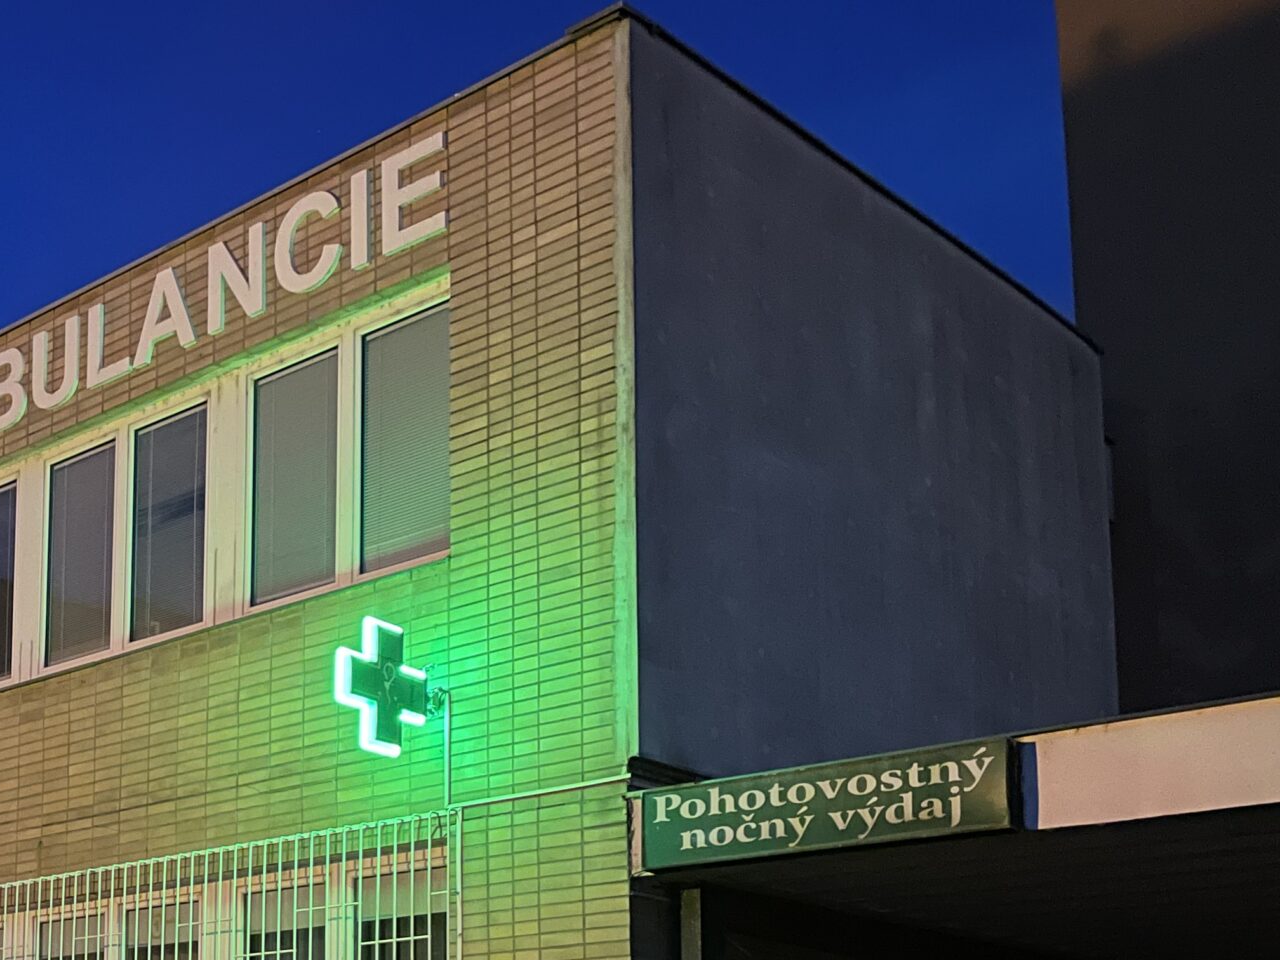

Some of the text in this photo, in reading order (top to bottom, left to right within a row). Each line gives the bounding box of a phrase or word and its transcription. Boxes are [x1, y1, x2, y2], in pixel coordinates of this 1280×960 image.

[652, 746, 995, 824] Pohotovostný
[680, 785, 962, 852] nočný výdaj
